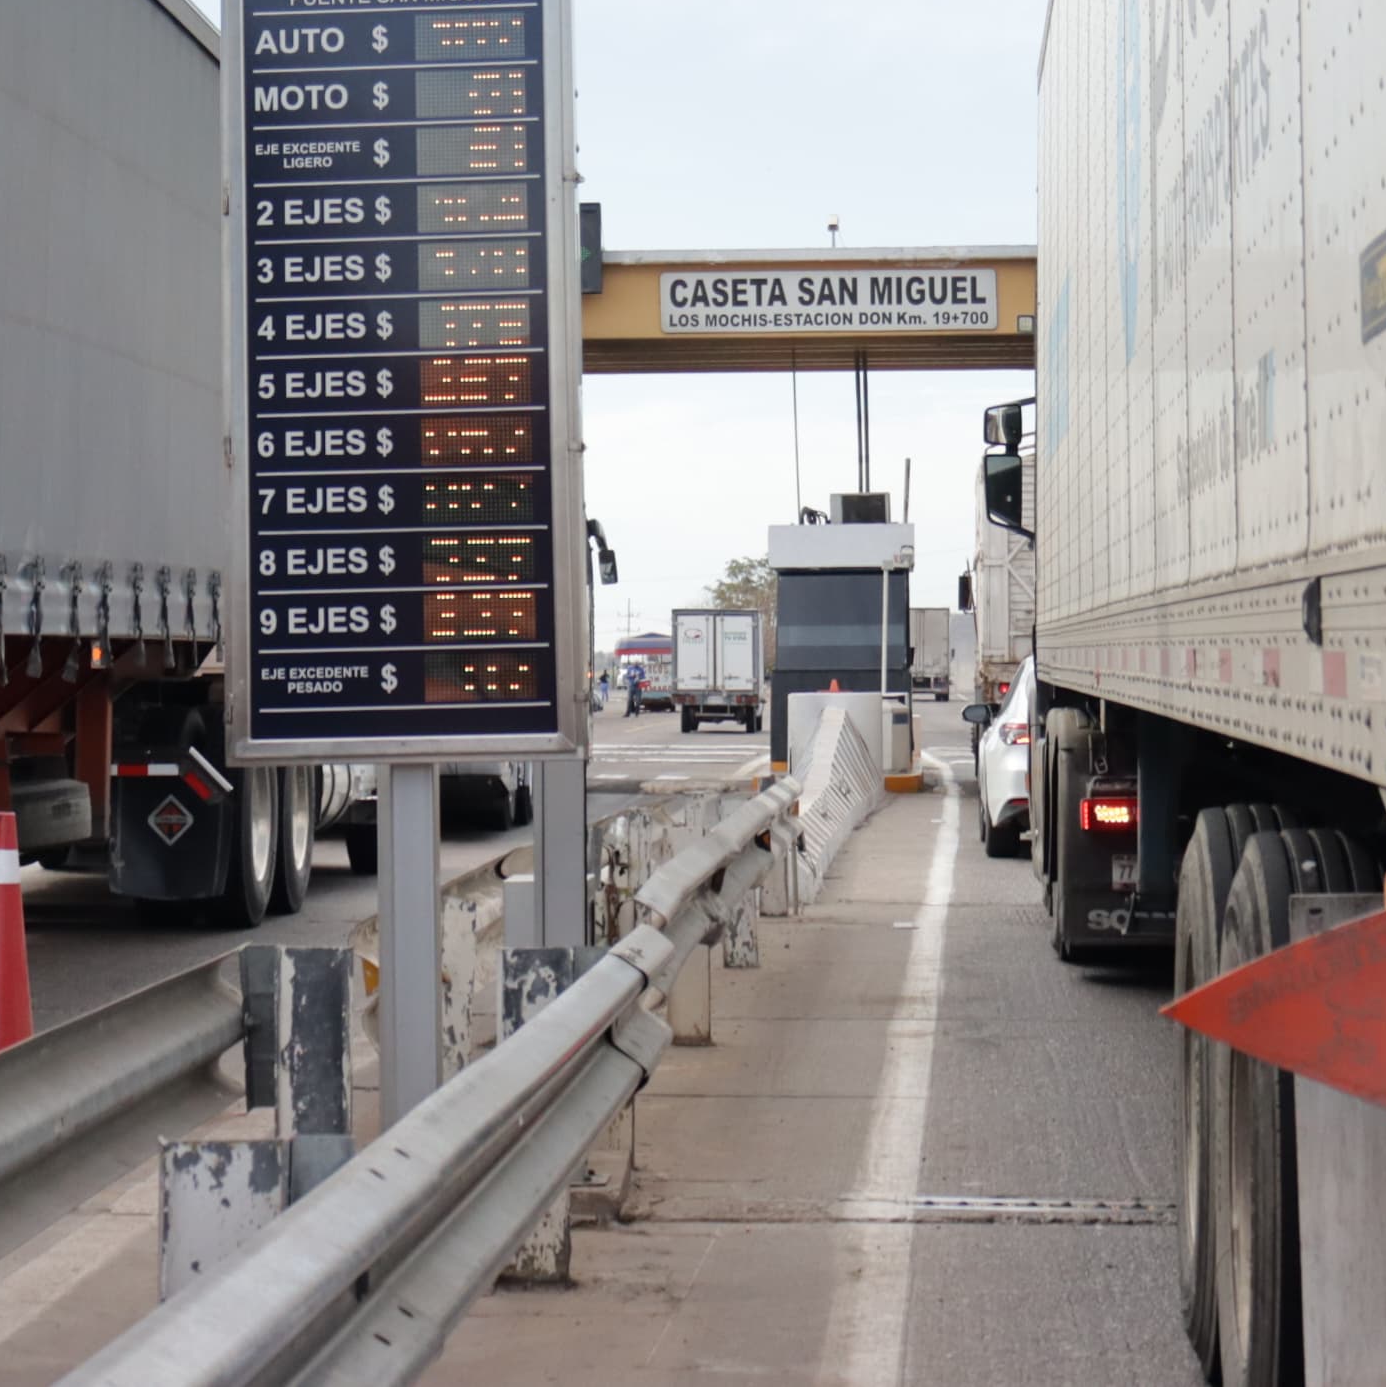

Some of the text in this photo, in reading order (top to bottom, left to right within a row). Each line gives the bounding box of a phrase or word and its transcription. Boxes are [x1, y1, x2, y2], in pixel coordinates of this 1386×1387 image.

[254, 24, 389, 55] AUTO $
[254, 81, 390, 112] MOTO $
[255, 141, 361, 155] EJE EXCEDENTE
[283, 156, 333, 168] LIGERO
[373, 138, 390, 167] $
[256, 195, 391, 227] 2 EJES $
[257, 253, 392, 283] 3 EJES $
[669, 276, 987, 308] CASETA SAN MIGUEL
[257, 310, 393, 341] 4 EJES $
[669, 311, 989, 328] LOS MOCHIS-ESTACION DON Km. 19+700
[258, 373, 275, 399] 5
[286, 370, 366, 398] EJES
[376, 368, 393, 398] $
[257, 431, 274, 457] 6
[285, 428, 366, 456] EJES
[376, 426, 393, 456] $
[258, 489, 276, 514] 7
[287, 487, 367, 514] EJES
[378, 484, 395, 514] $
[259, 545, 396, 576] 8 EJES $
[260, 604, 397, 635] 9 EJES $
[261, 666, 369, 680] EJE EXCEDENTE
[287, 681, 343, 694] PESADO
[381, 662, 398, 694] $
